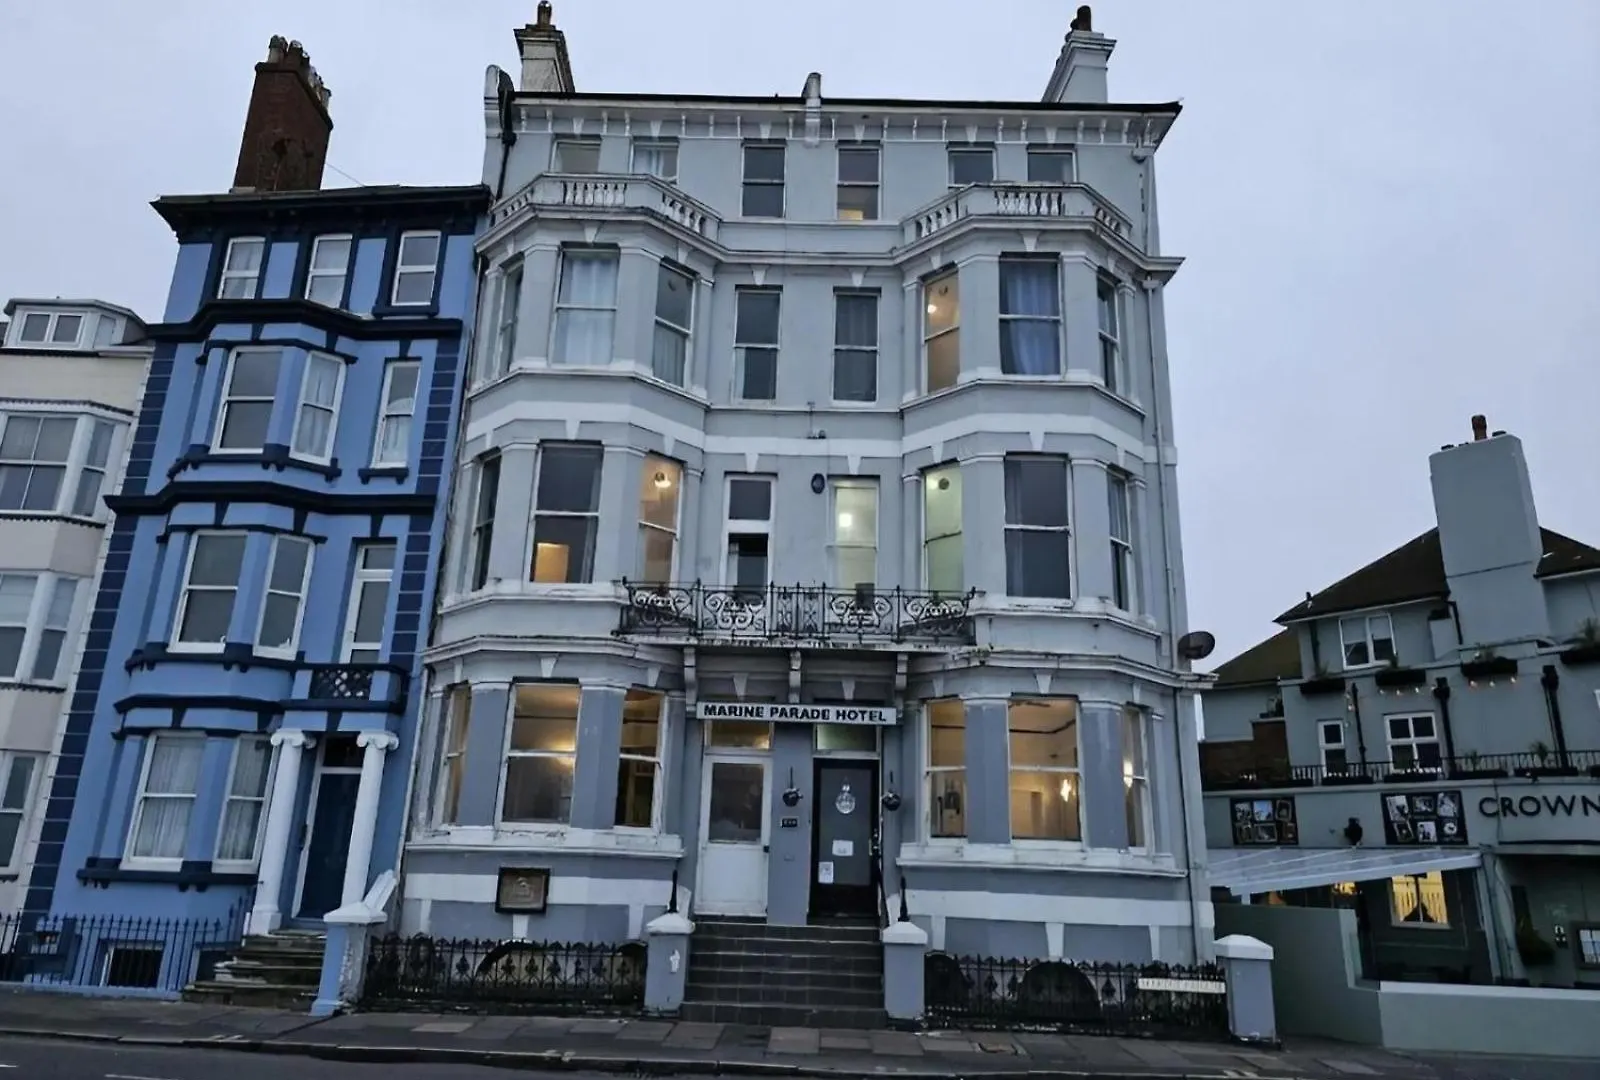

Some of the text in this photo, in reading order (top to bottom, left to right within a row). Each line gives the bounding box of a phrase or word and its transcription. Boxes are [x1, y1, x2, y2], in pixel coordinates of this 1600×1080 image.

[704, 704, 887, 722] MARINE PARADE HOTEL
[1479, 795, 1600, 818] CROWN
